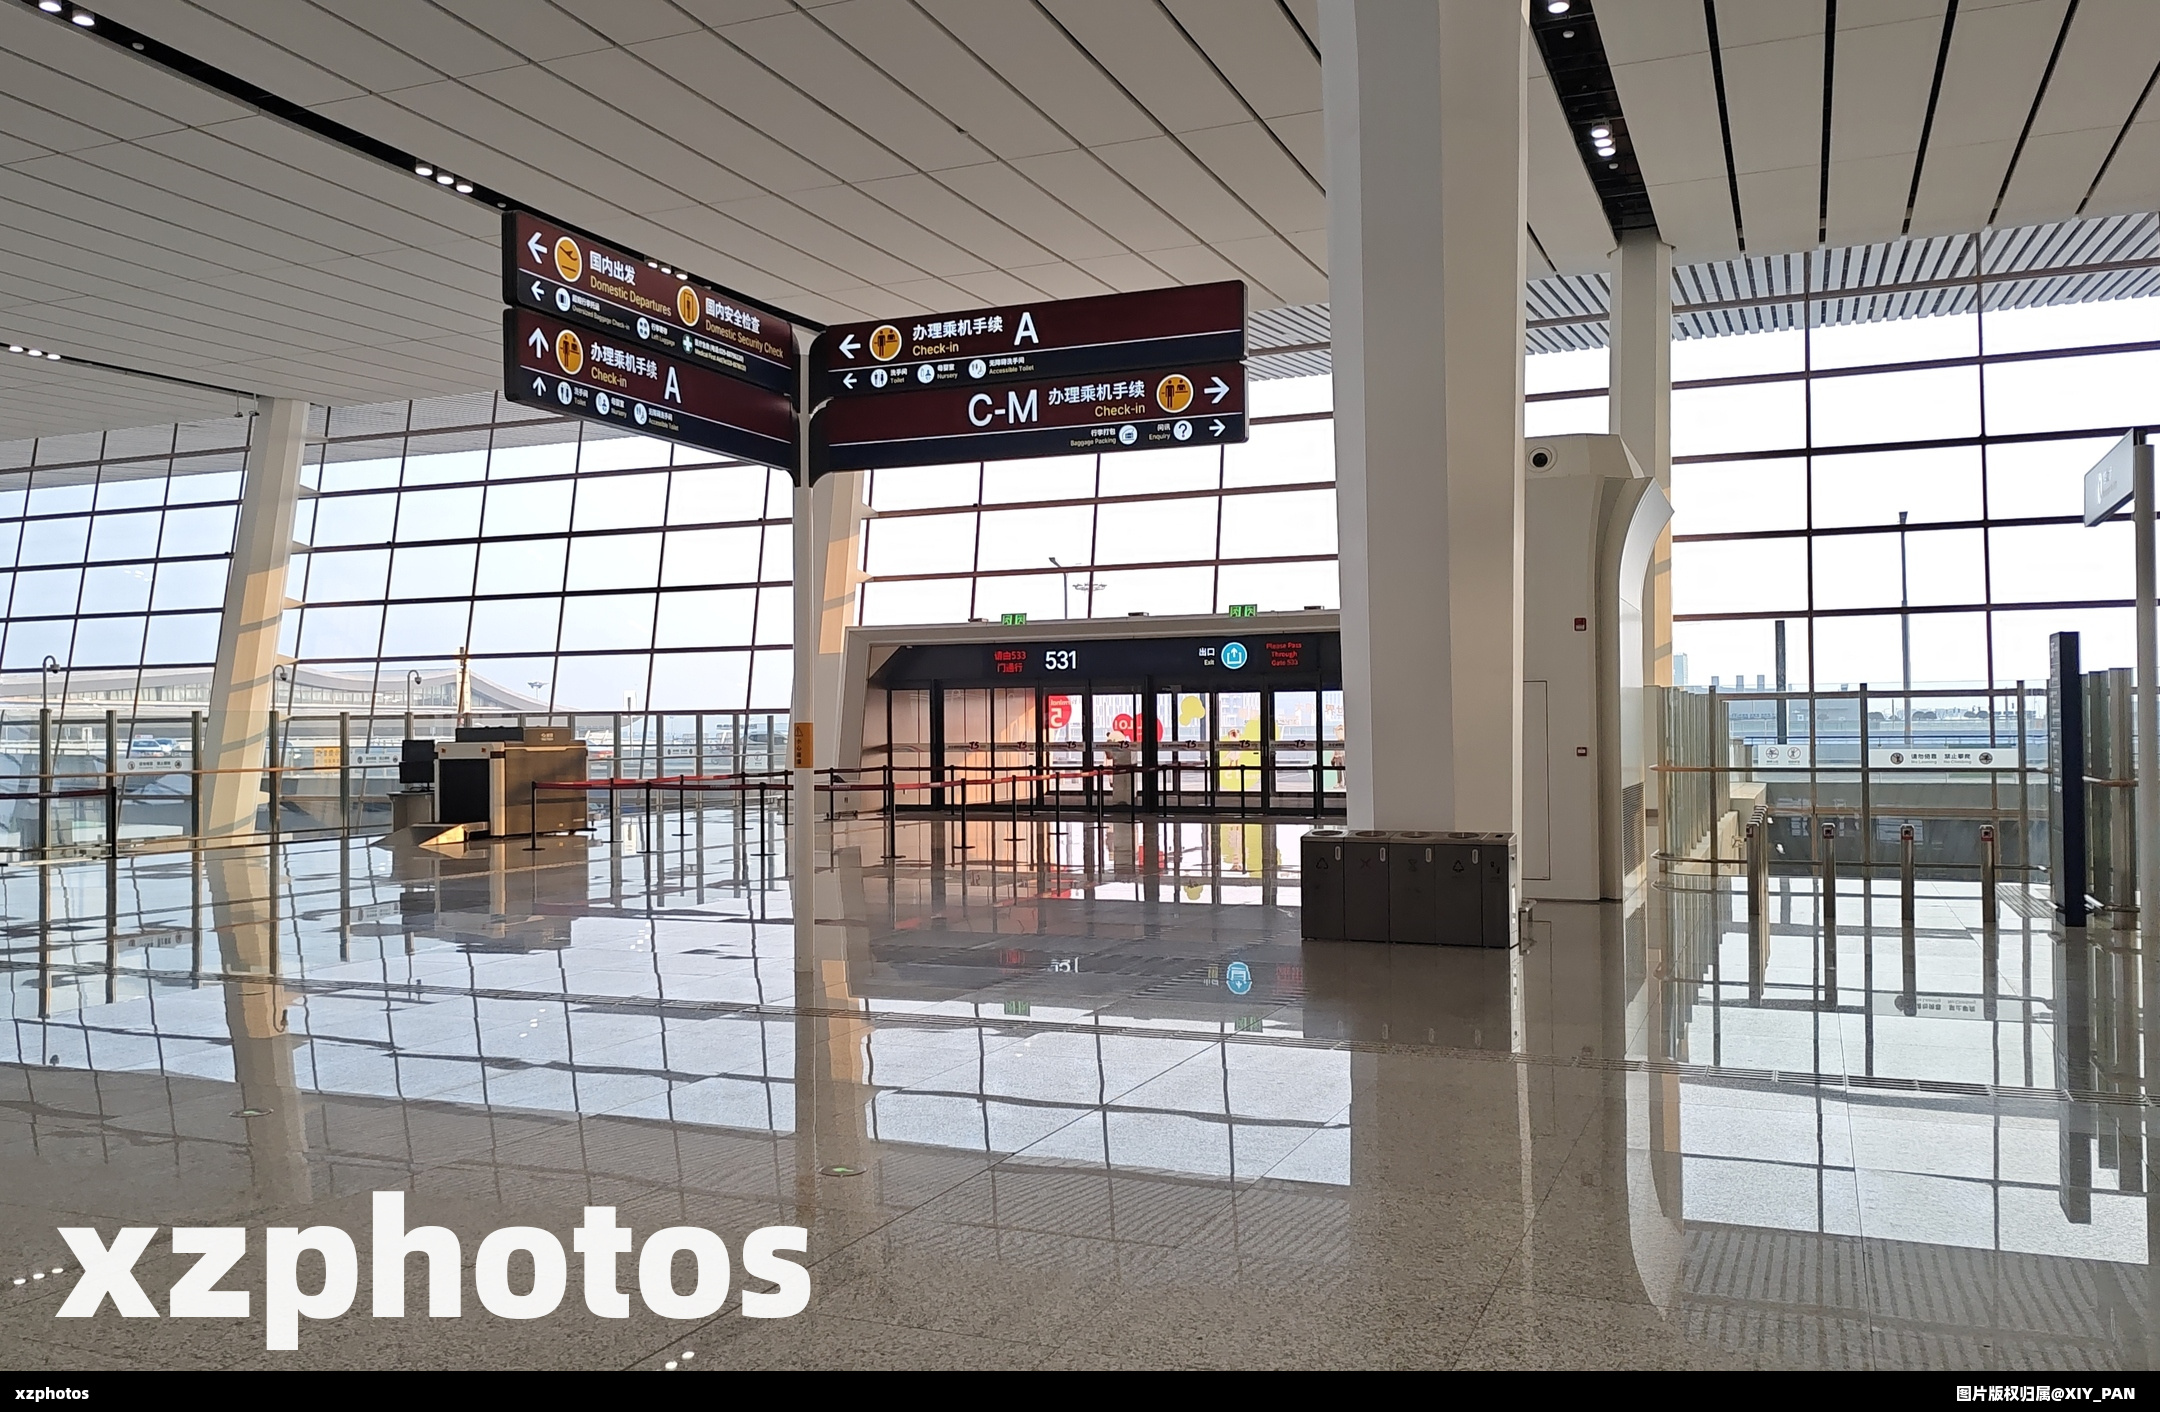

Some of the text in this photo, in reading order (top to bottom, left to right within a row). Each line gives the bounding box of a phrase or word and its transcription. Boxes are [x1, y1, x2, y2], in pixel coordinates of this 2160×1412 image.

[589, 250, 636, 286] 国内出发
[590, 276, 629, 301] Domestic
[629, 290, 672, 317] Departures
[705, 297, 760, 335] 国内安全检查
[913, 315, 1004, 341] 办理乘机手续
[1013, 311, 1040, 346] A
[705, 319, 737, 341] Domestic
[737, 331, 764, 353] Security
[763, 342, 784, 358] Check
[912, 341, 960, 357] Check-in
[590, 341, 658, 380] 办理乘机手续
[989, 364, 1035, 375] Accessible Toilet
[590, 368, 628, 388] Check-in
[663, 366, 682, 404] A
[890, 376, 905, 384] Toilet
[937, 371, 958, 380] Nursery
[1048, 380, 1146, 406] 办理乘机手续
[968, 389, 1039, 427] C-M
[1094, 404, 1146, 418] Check-in
[1070, 437, 1117, 447] Baggage Packing
[1148, 433, 1171, 441] Enquiry
[1045, 650, 1077, 670] 531
[1198, 647, 1216, 657] 出口
[1271, 651, 1298, 659] Through
